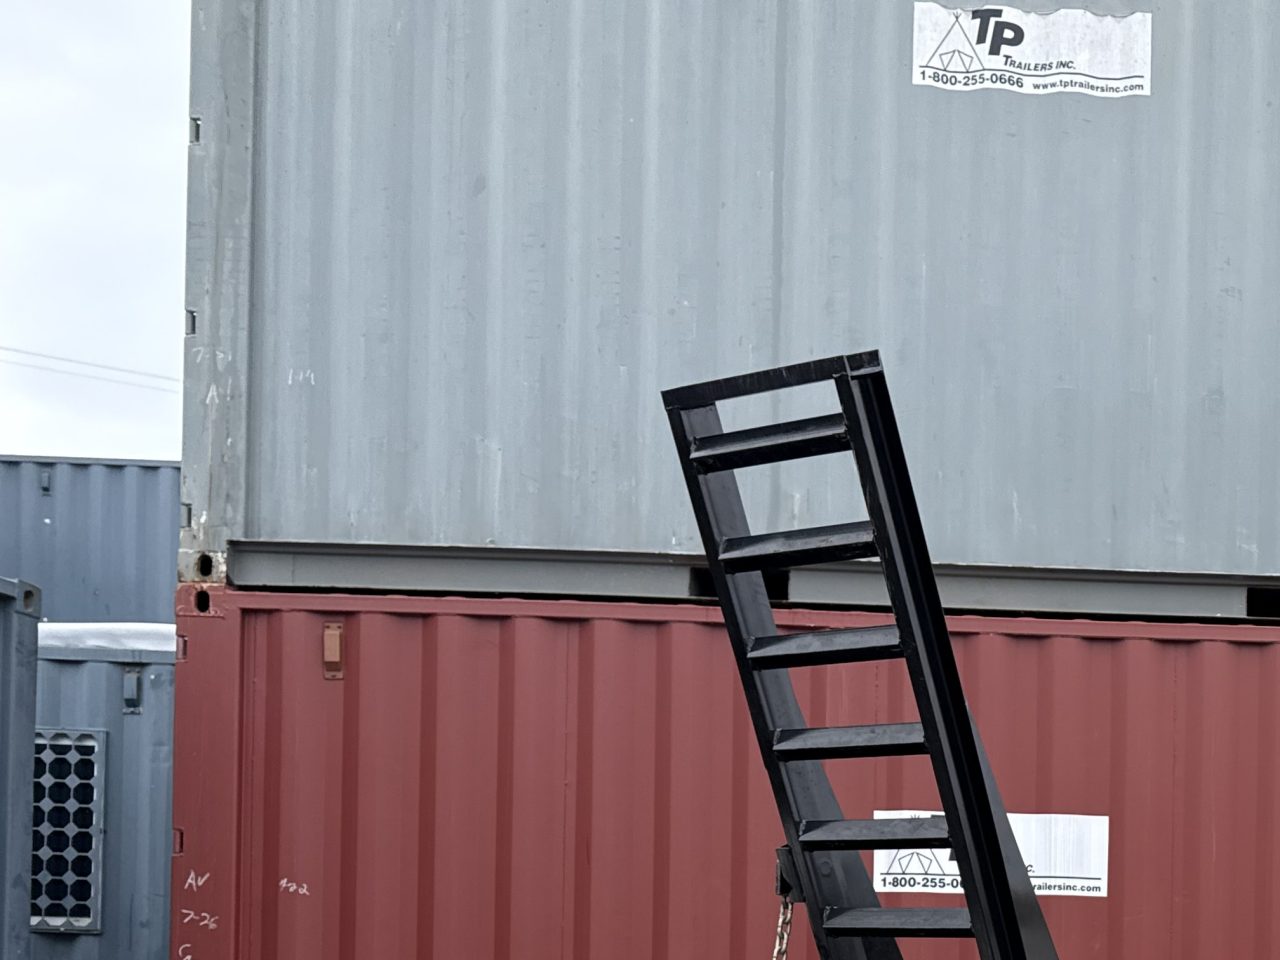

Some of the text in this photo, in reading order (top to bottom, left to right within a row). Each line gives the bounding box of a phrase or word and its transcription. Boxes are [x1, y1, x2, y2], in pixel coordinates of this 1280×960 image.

[971, 9, 1024, 56] TP
[1055, 60, 1076, 69] INC.
[920, 70, 1144, 93] 1-800-255-0666 www.tptrailersinc.com
[881, 876, 1102, 893] 1-800-255-0 railersinc.com
